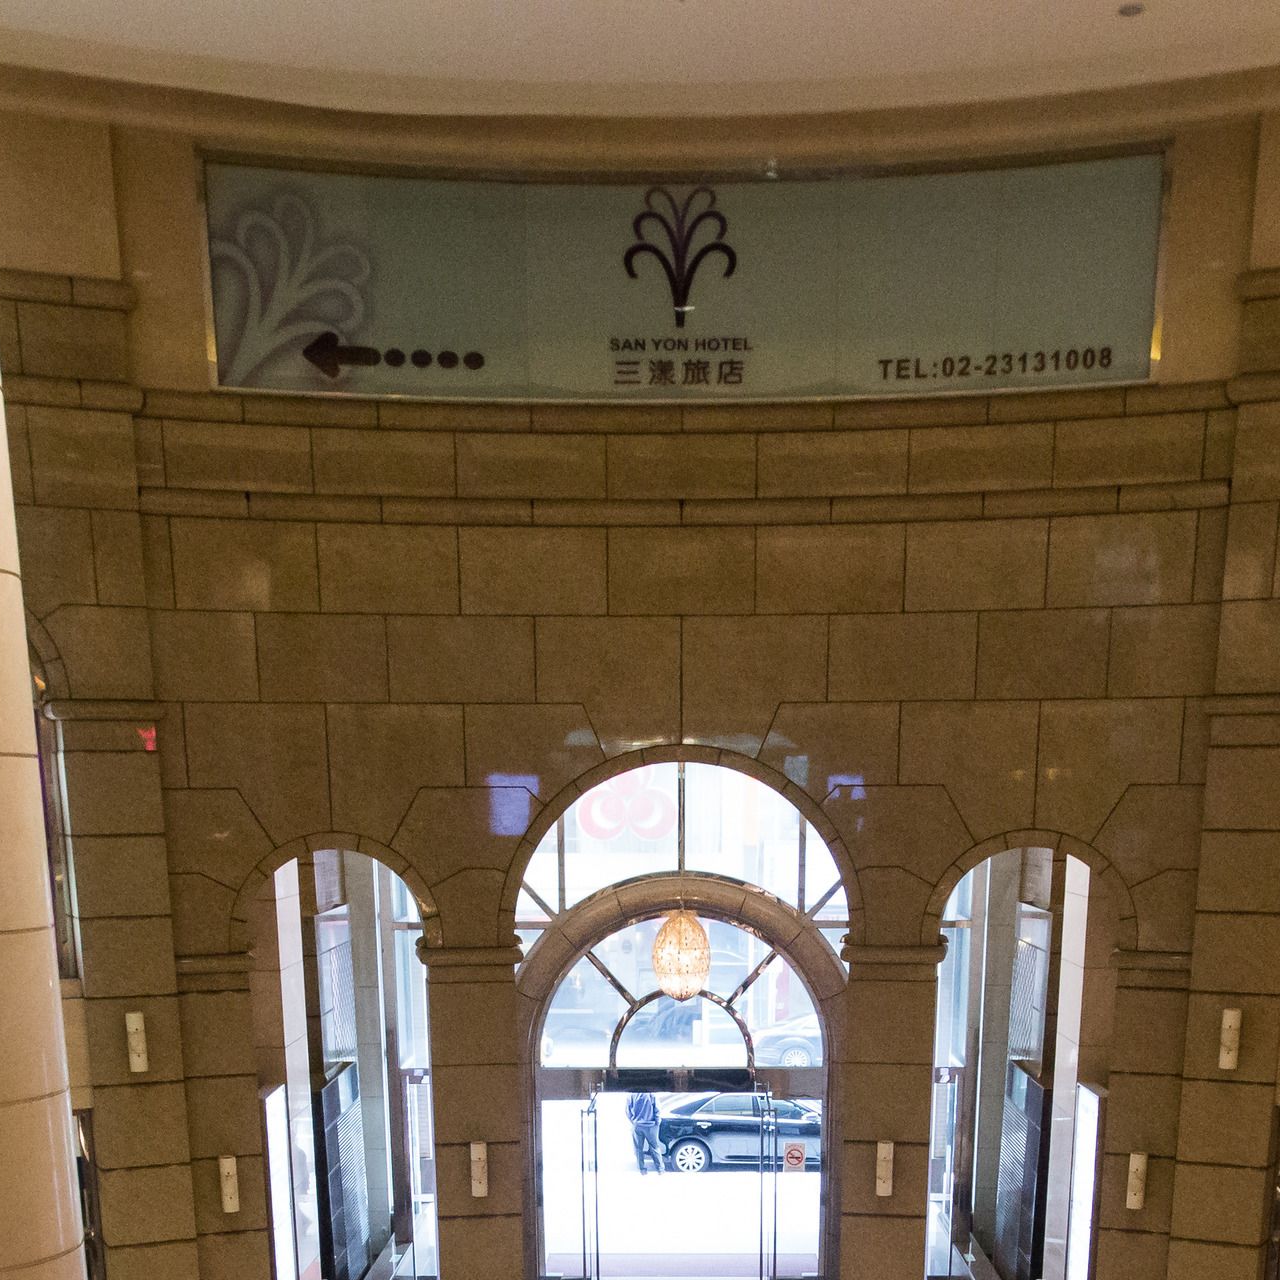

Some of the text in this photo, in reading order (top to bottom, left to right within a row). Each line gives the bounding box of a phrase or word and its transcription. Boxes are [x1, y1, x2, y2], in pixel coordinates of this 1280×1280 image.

[610, 337, 753, 351] SAN YON HOTEL
[614, 359, 744, 385] 三漾旅店
[878, 347, 1113, 380] TEL:02-23131008
